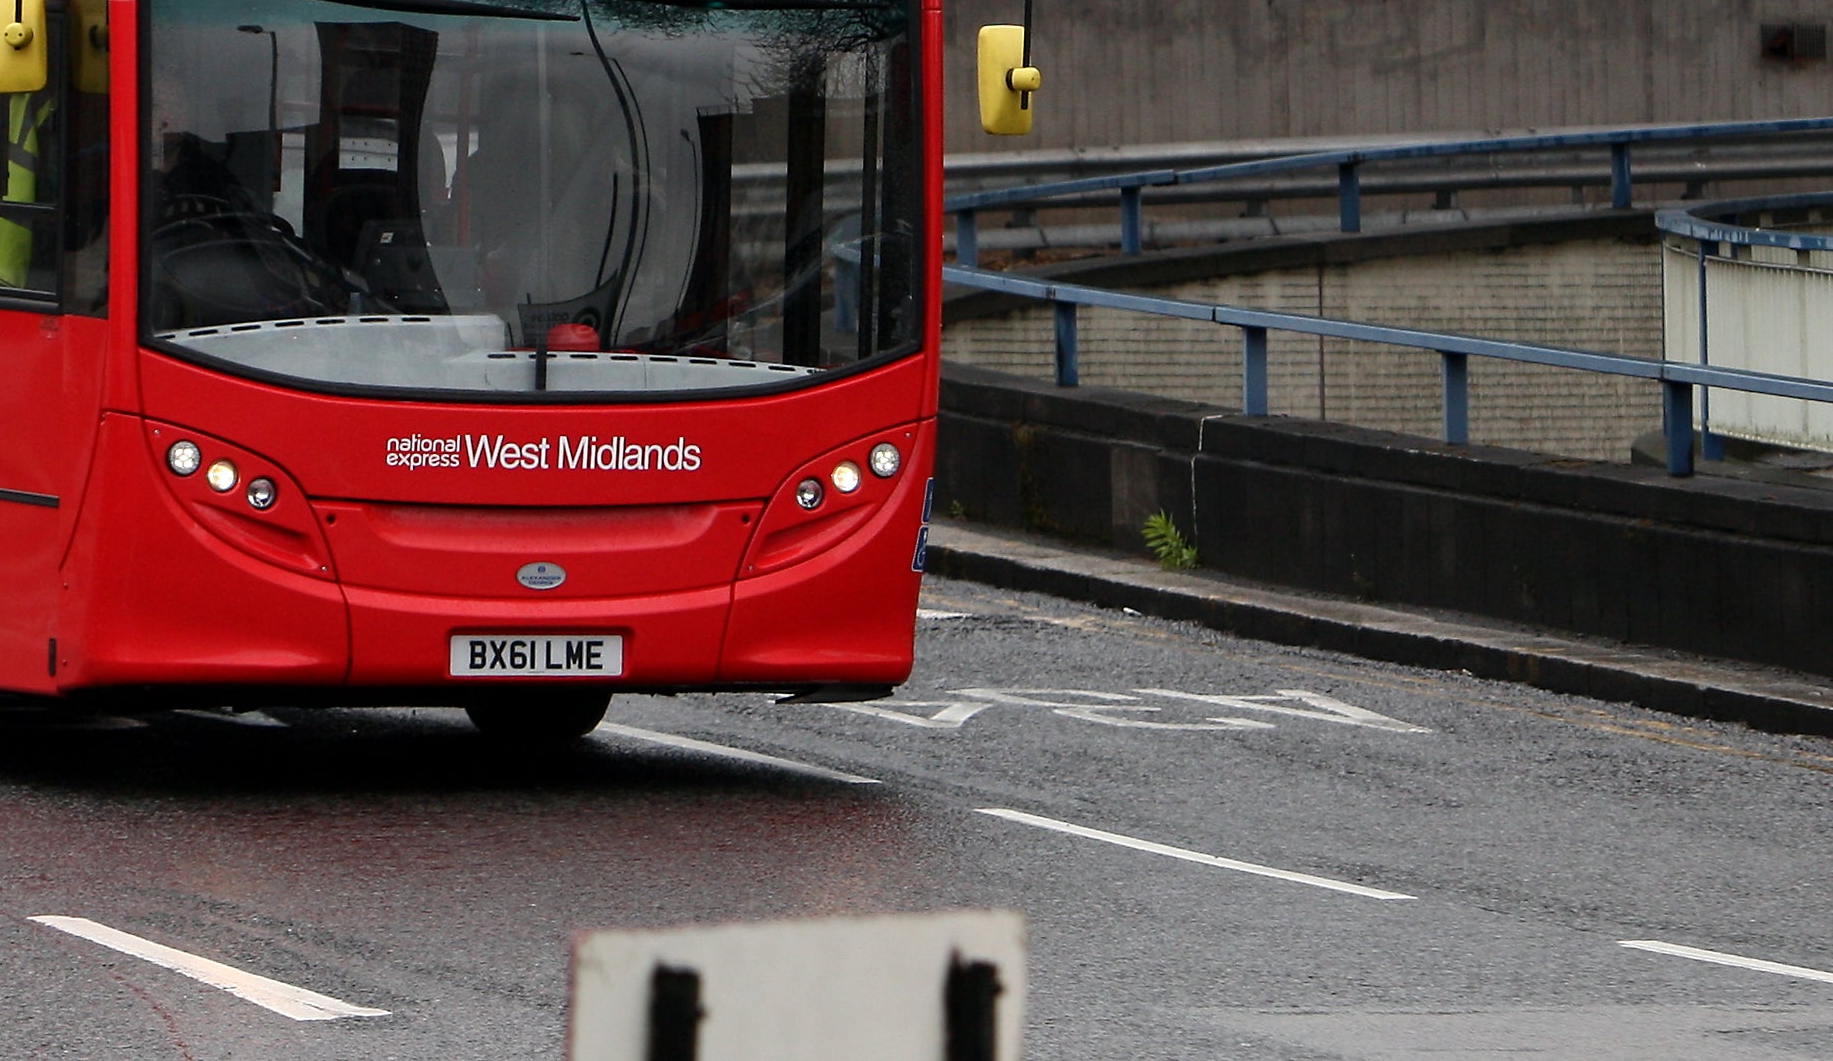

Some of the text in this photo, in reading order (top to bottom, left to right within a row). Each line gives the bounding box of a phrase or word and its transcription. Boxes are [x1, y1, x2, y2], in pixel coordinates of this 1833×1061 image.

[387, 434, 461, 452] national
[464, 434, 701, 471] West Midlands
[386, 452, 460, 471] express
[469, 640, 604, 670] BX61 LME
